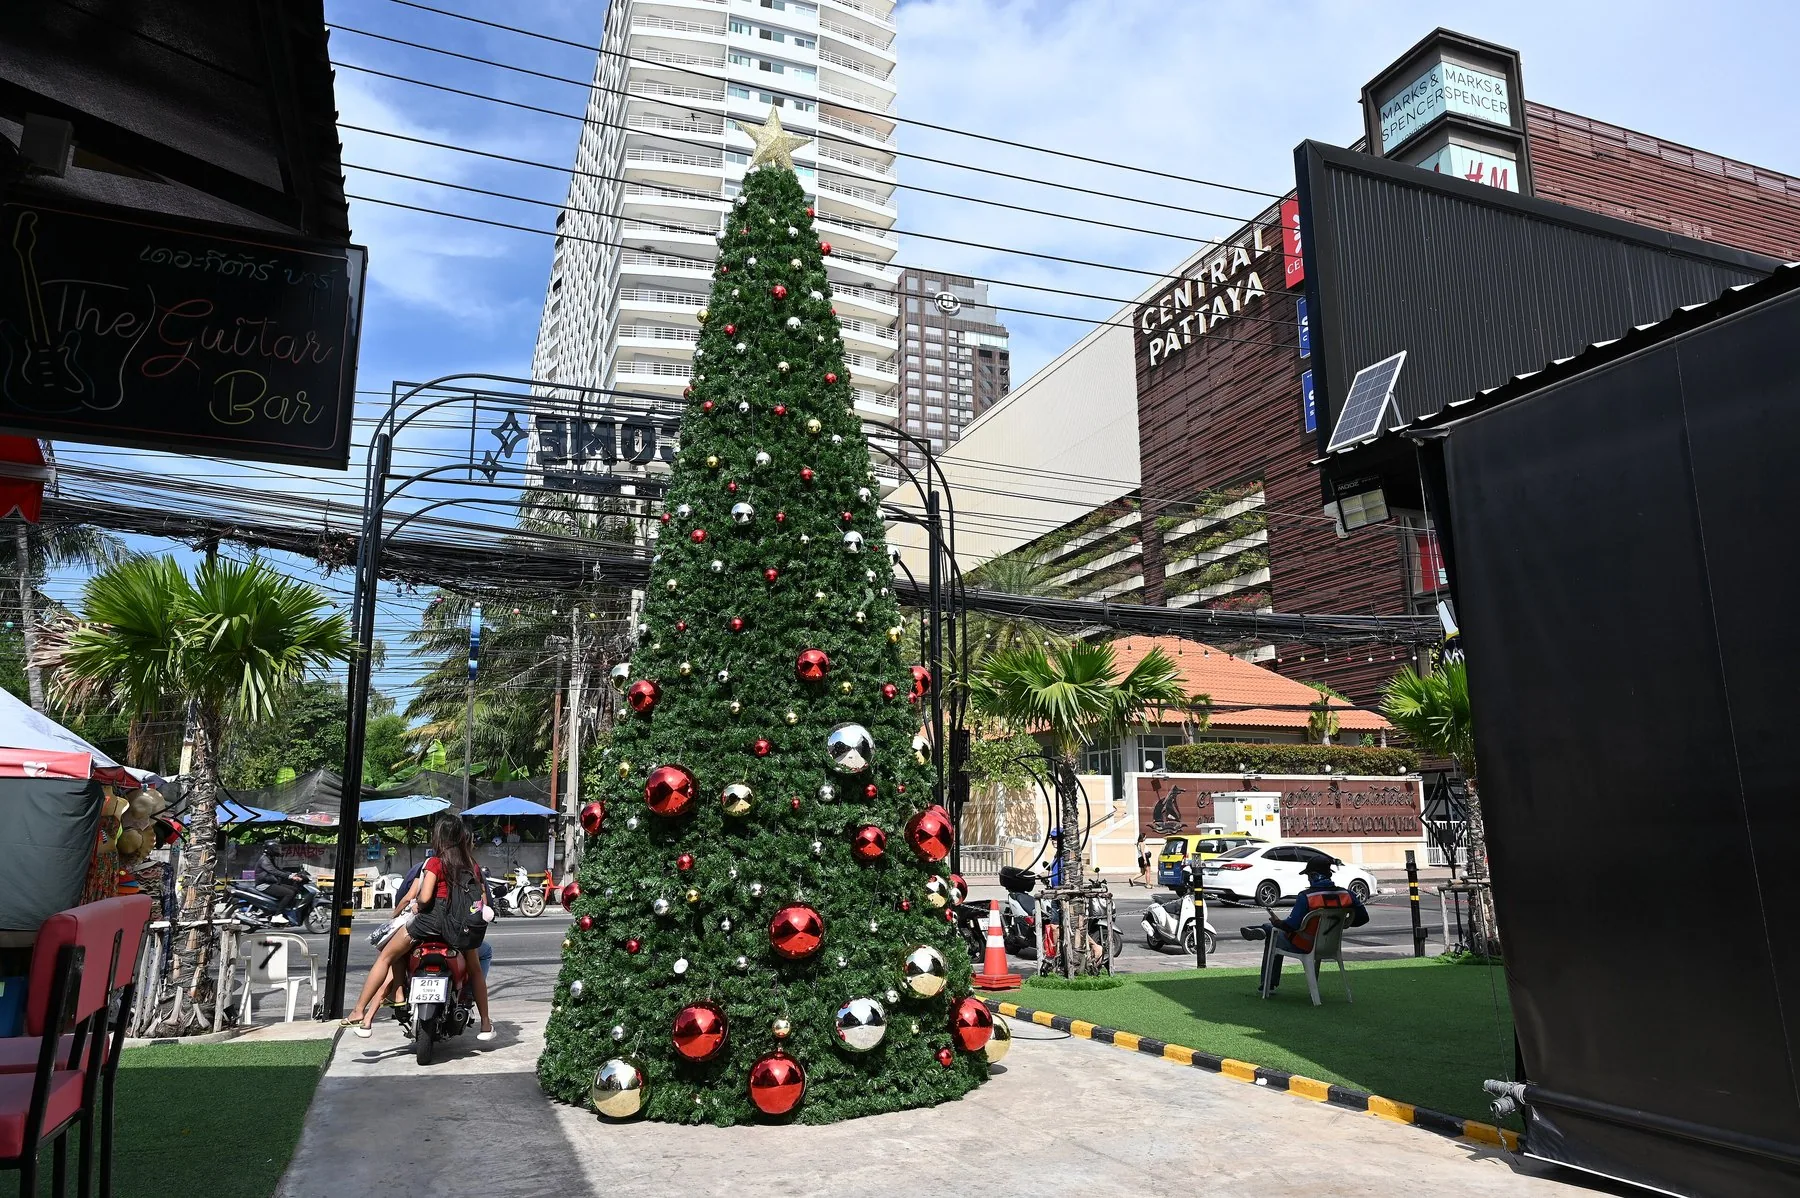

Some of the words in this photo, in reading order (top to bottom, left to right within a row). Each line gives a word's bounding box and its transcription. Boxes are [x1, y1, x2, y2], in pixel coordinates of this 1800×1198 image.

[1382, 80, 1427, 124] MARKS
[1430, 73, 1439, 88] &
[1445, 68, 1492, 93] MARKS
[1494, 83, 1504, 96] &
[1445, 86, 1509, 115] SPENCER
[1382, 87, 1445, 142] SPENCER
[1141, 229, 1272, 336] CENTRAL
[39, 278, 146, 337] The
[141, 299, 333, 378] Guitar
[1149, 271, 1266, 367] PATTAYA
[209, 370, 325, 425] Bar
[257, 940, 283, 970] 7
[415, 993, 441, 1002] 4573
